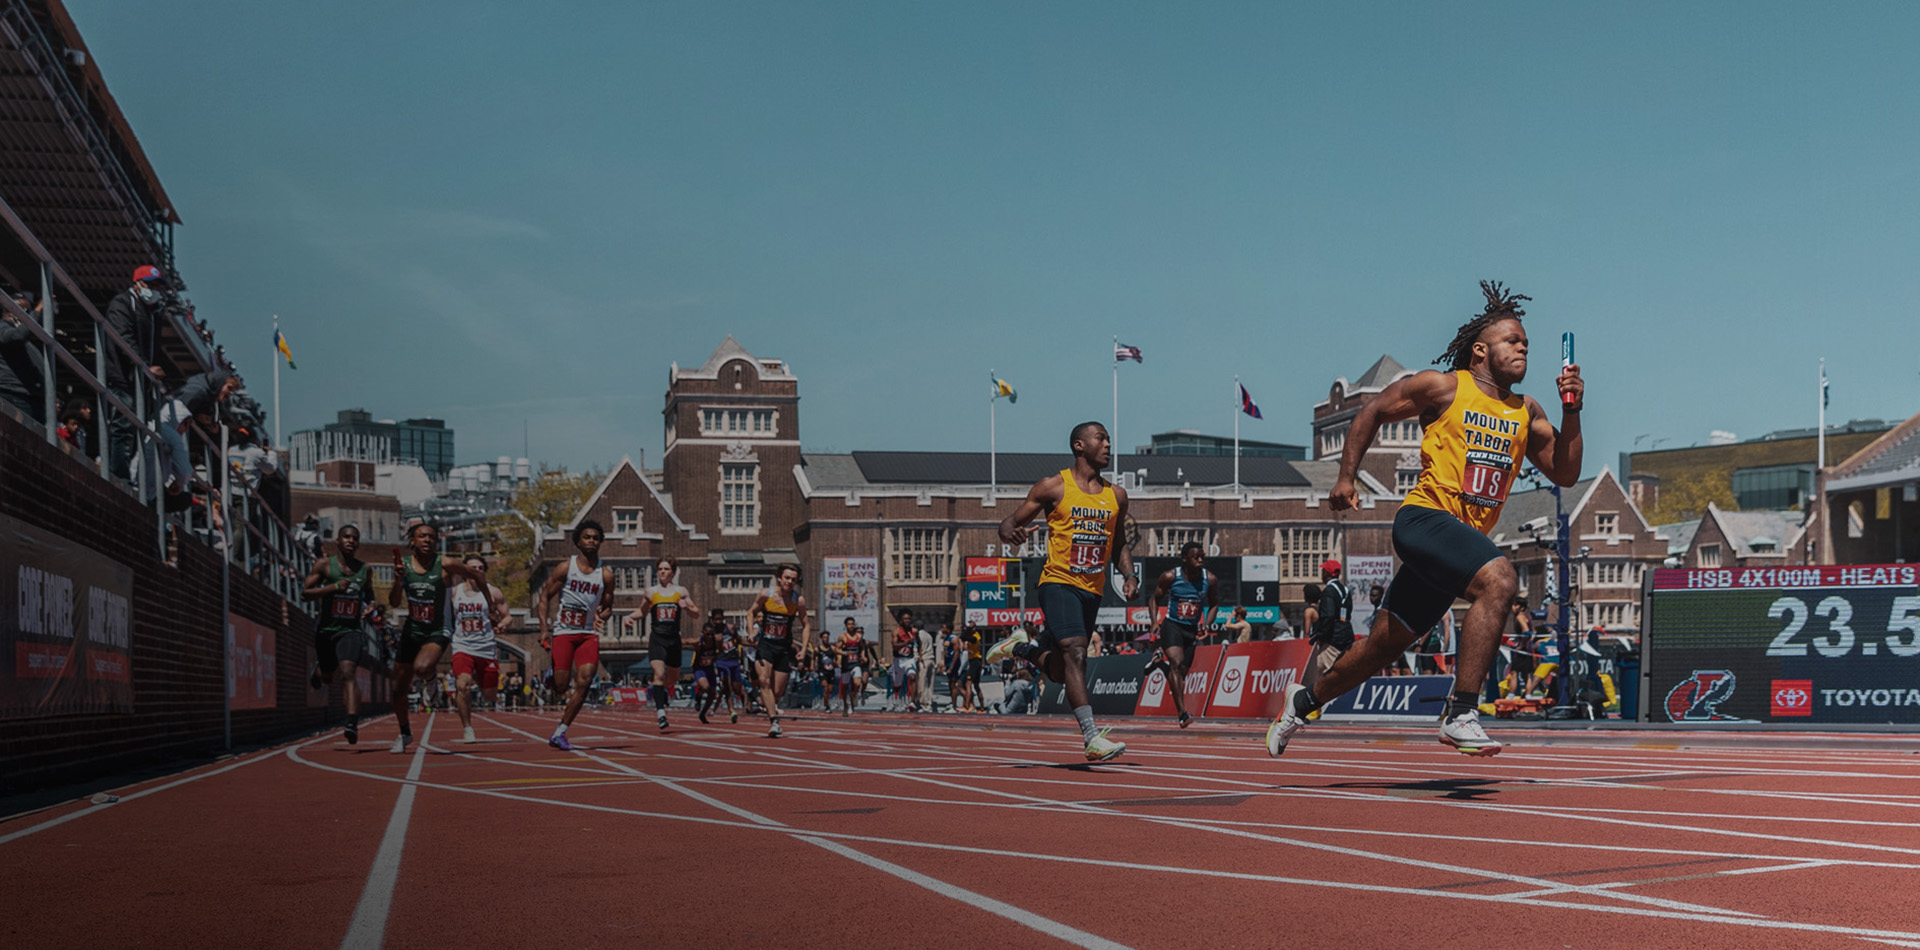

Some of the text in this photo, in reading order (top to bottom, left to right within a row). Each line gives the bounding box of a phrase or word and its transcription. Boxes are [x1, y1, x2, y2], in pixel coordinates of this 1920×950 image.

[1464, 410, 1520, 436] MOUNT
[1465, 429, 1512, 454] TABOR
[1466, 450, 1488, 459] PENN
[1475, 497, 1499, 507] TOYOTA
[1071, 507, 1112, 520] MOUNT
[1073, 520, 1106, 532] TABOR
[986, 543, 1045, 557] FRAN
[1687, 570, 1732, 588] HSB
[1739, 568, 1821, 587] 4X100M
[1841, 567, 1916, 585] HEATS
[570, 579, 599, 595] RYAN
[981, 590, 1005, 601] PNC
[18, 563, 74, 639] CORE POWER
[458, 603, 483, 613] RYAN
[1110, 624, 1149, 632] FAMIL
[1092, 677, 1138, 695] Run on clouds.
[1183, 672, 1208, 694] YOTA
[1251, 668, 1297, 694] TOYOTA
[1352, 681, 1418, 711] LYNX
[1821, 689, 1920, 707] TOYOTA
